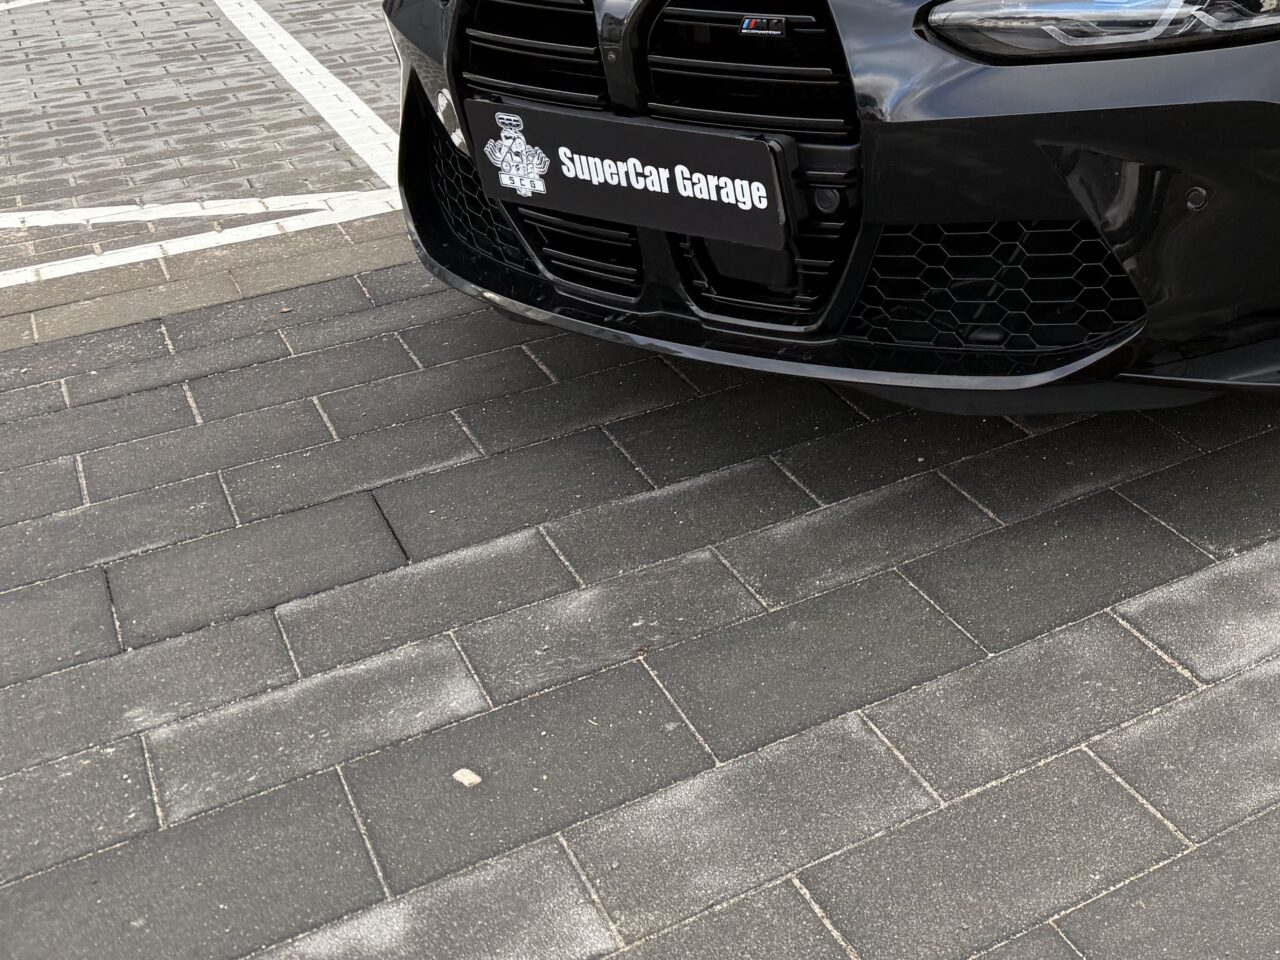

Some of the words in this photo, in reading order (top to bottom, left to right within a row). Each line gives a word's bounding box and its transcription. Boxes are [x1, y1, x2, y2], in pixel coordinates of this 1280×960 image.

[509, 176, 536, 189] SCG
[558, 146, 670, 194] SuperCar
[674, 164, 768, 211] Garage
